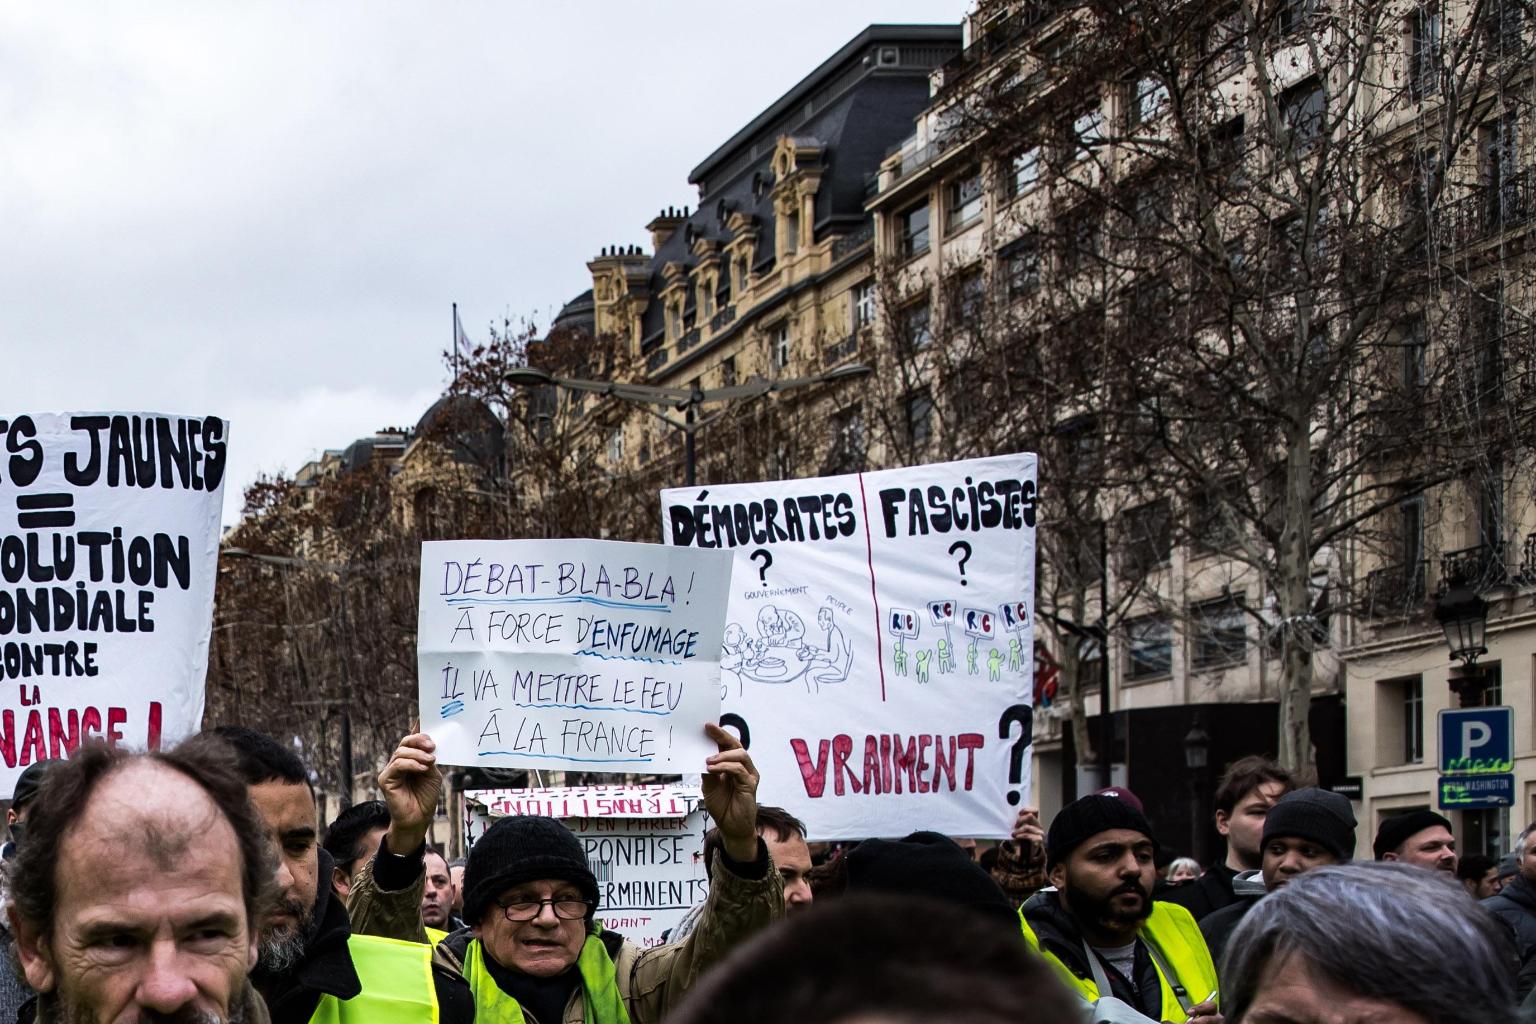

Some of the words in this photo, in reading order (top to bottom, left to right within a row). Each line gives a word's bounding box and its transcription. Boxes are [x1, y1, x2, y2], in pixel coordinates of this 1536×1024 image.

[64, 415, 227, 492] JAUNES
[669, 490, 856, 548] DÉMOCRATES
[879, 477, 1036, 538] FASCISTES
[749, 548, 773, 587] ?
[948, 541, 972, 586] ?
[744, 585, 808, 600] GOUVERNEMENT
[825, 594, 854, 615] PEUPLE
[932, 602, 952, 620] RIC
[892, 613, 913, 630] RIC
[966, 611, 991, 633] RIC
[1004, 602, 1026, 627] RIC
[488, 610, 563, 643] FORCE
[576, 615, 699, 659] D'ENFUMAGE
[20, 684, 41, 705] LA
[473, 669, 498, 700] VA
[514, 670, 604, 704] METTRE
[614, 677, 635, 704] LE
[641, 681, 683, 711] FEU
[513, 717, 546, 754] LA
[563, 718, 655, 756] FRANCE
[790, 733, 984, 798] VRAIMENT
[999, 704, 1033, 806] ?
[1461, 720, 1492, 759] P
